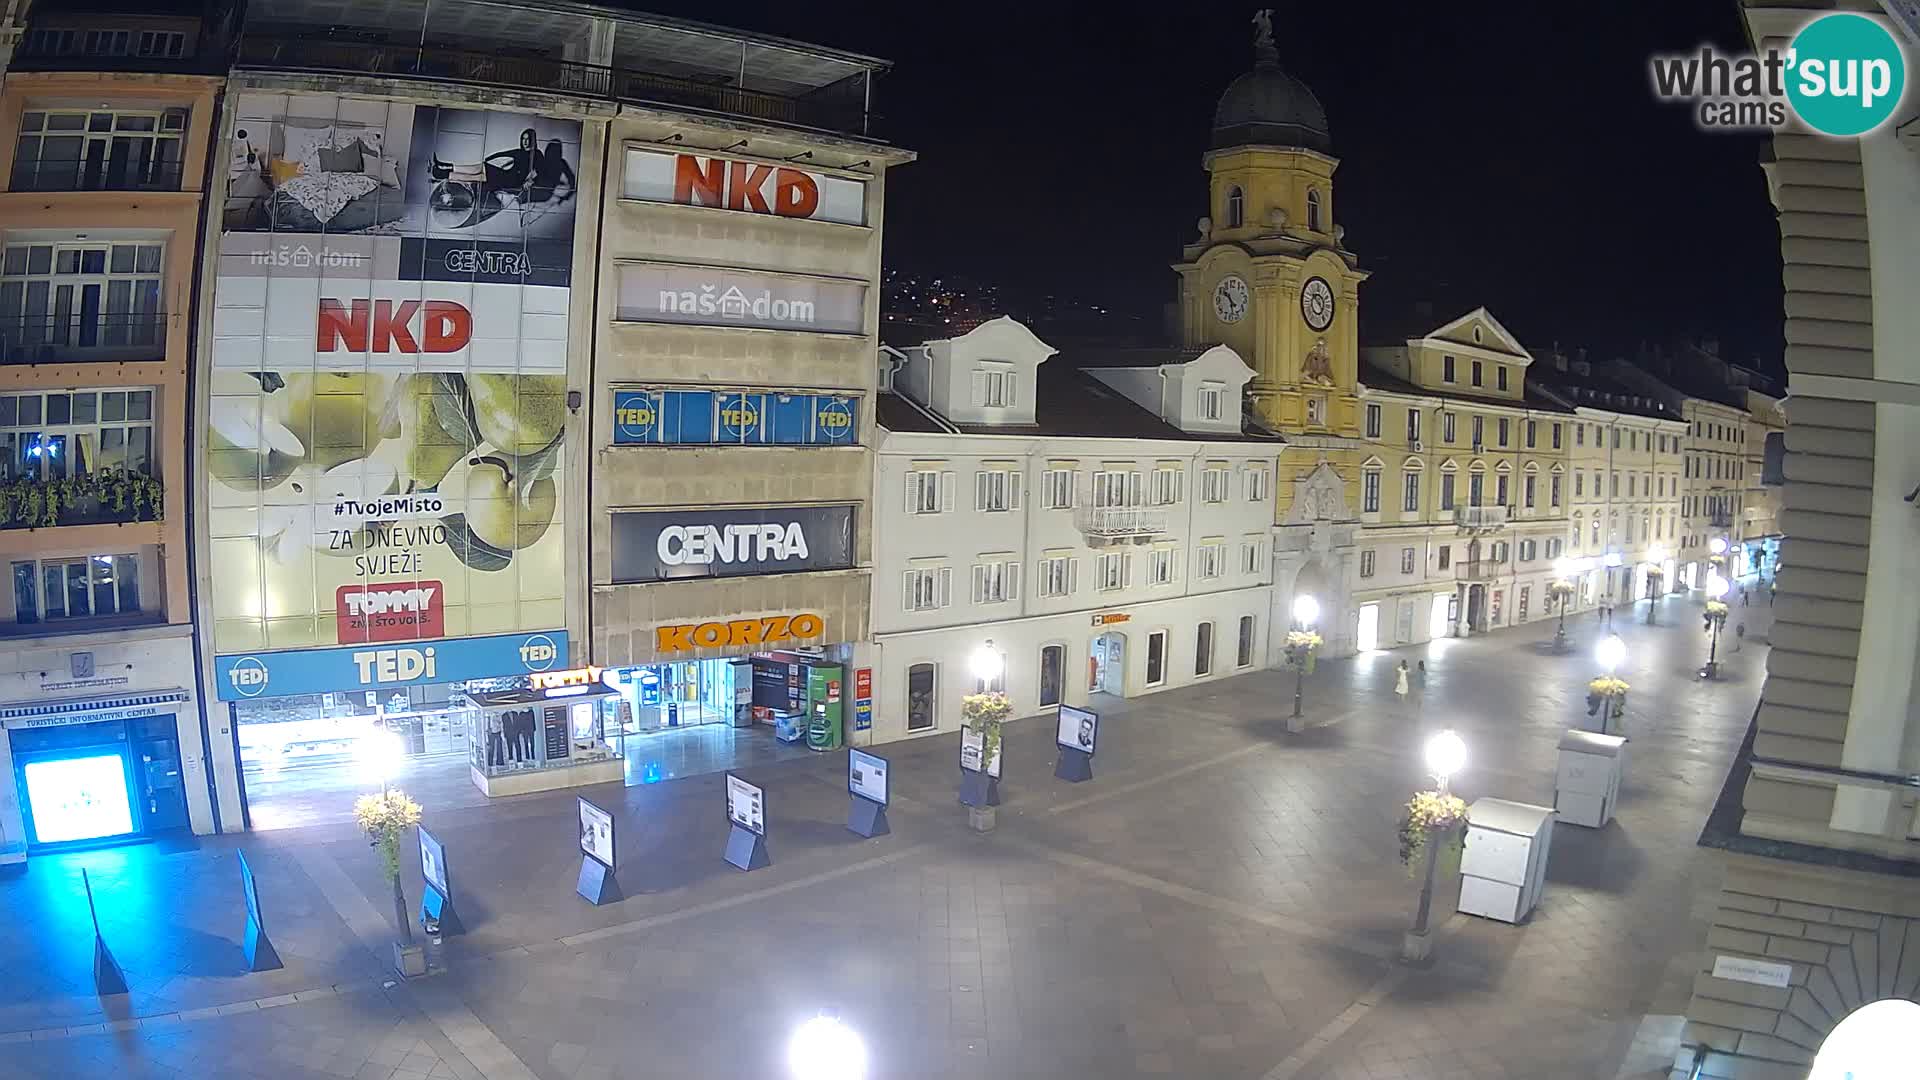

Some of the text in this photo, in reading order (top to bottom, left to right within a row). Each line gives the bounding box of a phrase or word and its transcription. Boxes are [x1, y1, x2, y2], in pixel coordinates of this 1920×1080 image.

[673, 153, 819, 218] NKD
[250, 245, 361, 268] naš dom
[445, 248, 531, 275] CENTRA
[660, 283, 815, 322] naš dom
[316, 298, 473, 353] NKD
[617, 408, 656, 426] TEDi
[722, 409, 758, 427] TEDi
[818, 411, 852, 428] TEDi
[334, 498, 443, 517] #TvojeMisto
[329, 525, 448, 550] ZA DNEVNO
[657, 522, 809, 566] CENTRA
[356, 549, 423, 577] SVJEŽE
[345, 586, 436, 616] TOMMY
[376, 614, 396, 627] ŠTO
[656, 613, 824, 652] KORZO
[354, 647, 437, 684] TEDi
[519, 643, 557, 664] TEDi
[229, 665, 269, 687] TEDi
[126, 708, 157, 718] CENTAR
